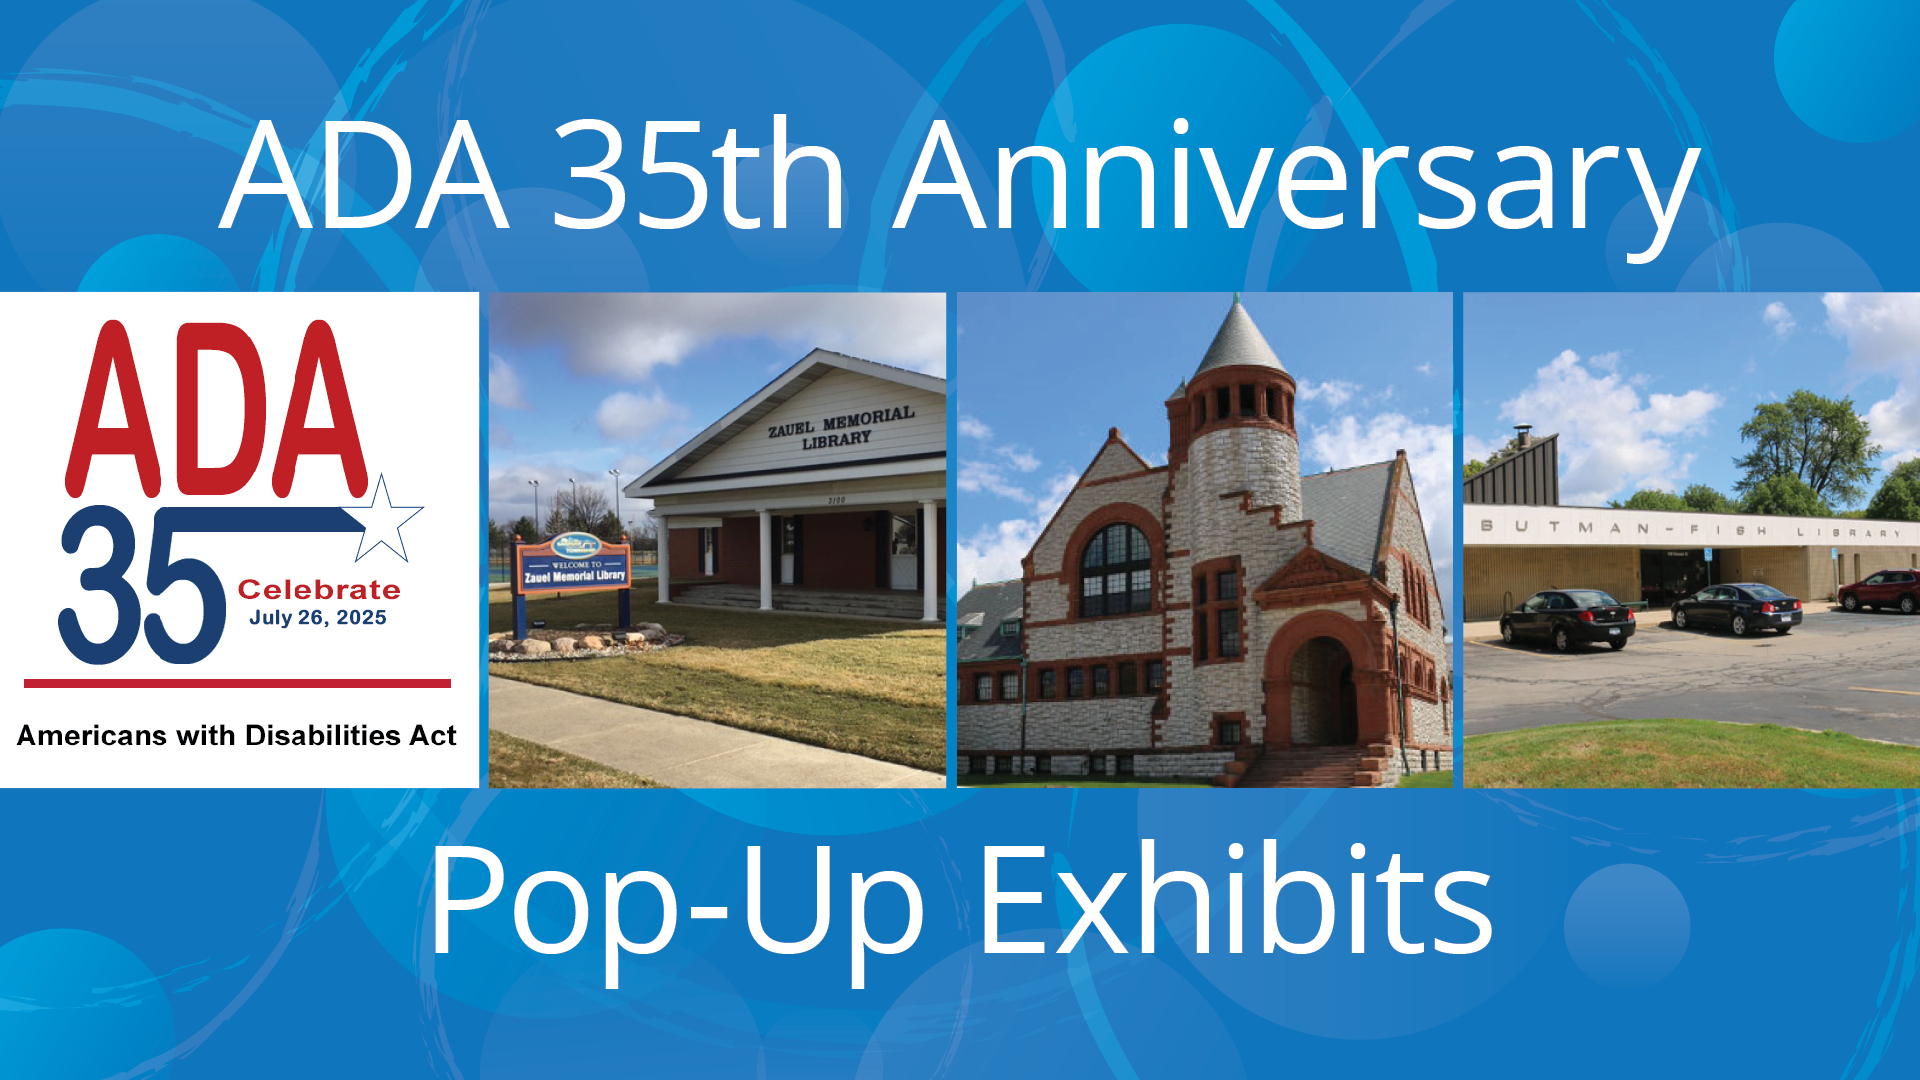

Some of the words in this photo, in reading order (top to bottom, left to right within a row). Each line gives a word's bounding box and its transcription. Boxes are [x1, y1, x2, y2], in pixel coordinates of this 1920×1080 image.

[64, 319, 369, 498] ADA
[768, 421, 815, 438] ZAUEL
[823, 405, 915, 431] MEMORIAL
[802, 430, 872, 450] LIBRARY
[828, 496, 846, 505] 3100
[1480, 519, 1766, 536] BUTMAN-FISH
[1797, 527, 1901, 538] LIBRARY
[58, 504, 229, 665] 35
[524, 572, 551, 583] Zauel
[552, 570, 594, 582] Memorial
[596, 570, 626, 581] Library
[238, 578, 401, 600] Celebrate
[249, 609, 293, 628] July
[298, 609, 329, 628] 26,
[336, 609, 387, 625] 2025
[16, 724, 167, 746] Americans
[175, 724, 235, 746] with
[246, 724, 401, 746] Disabilities
[408, 724, 457, 746] Act
